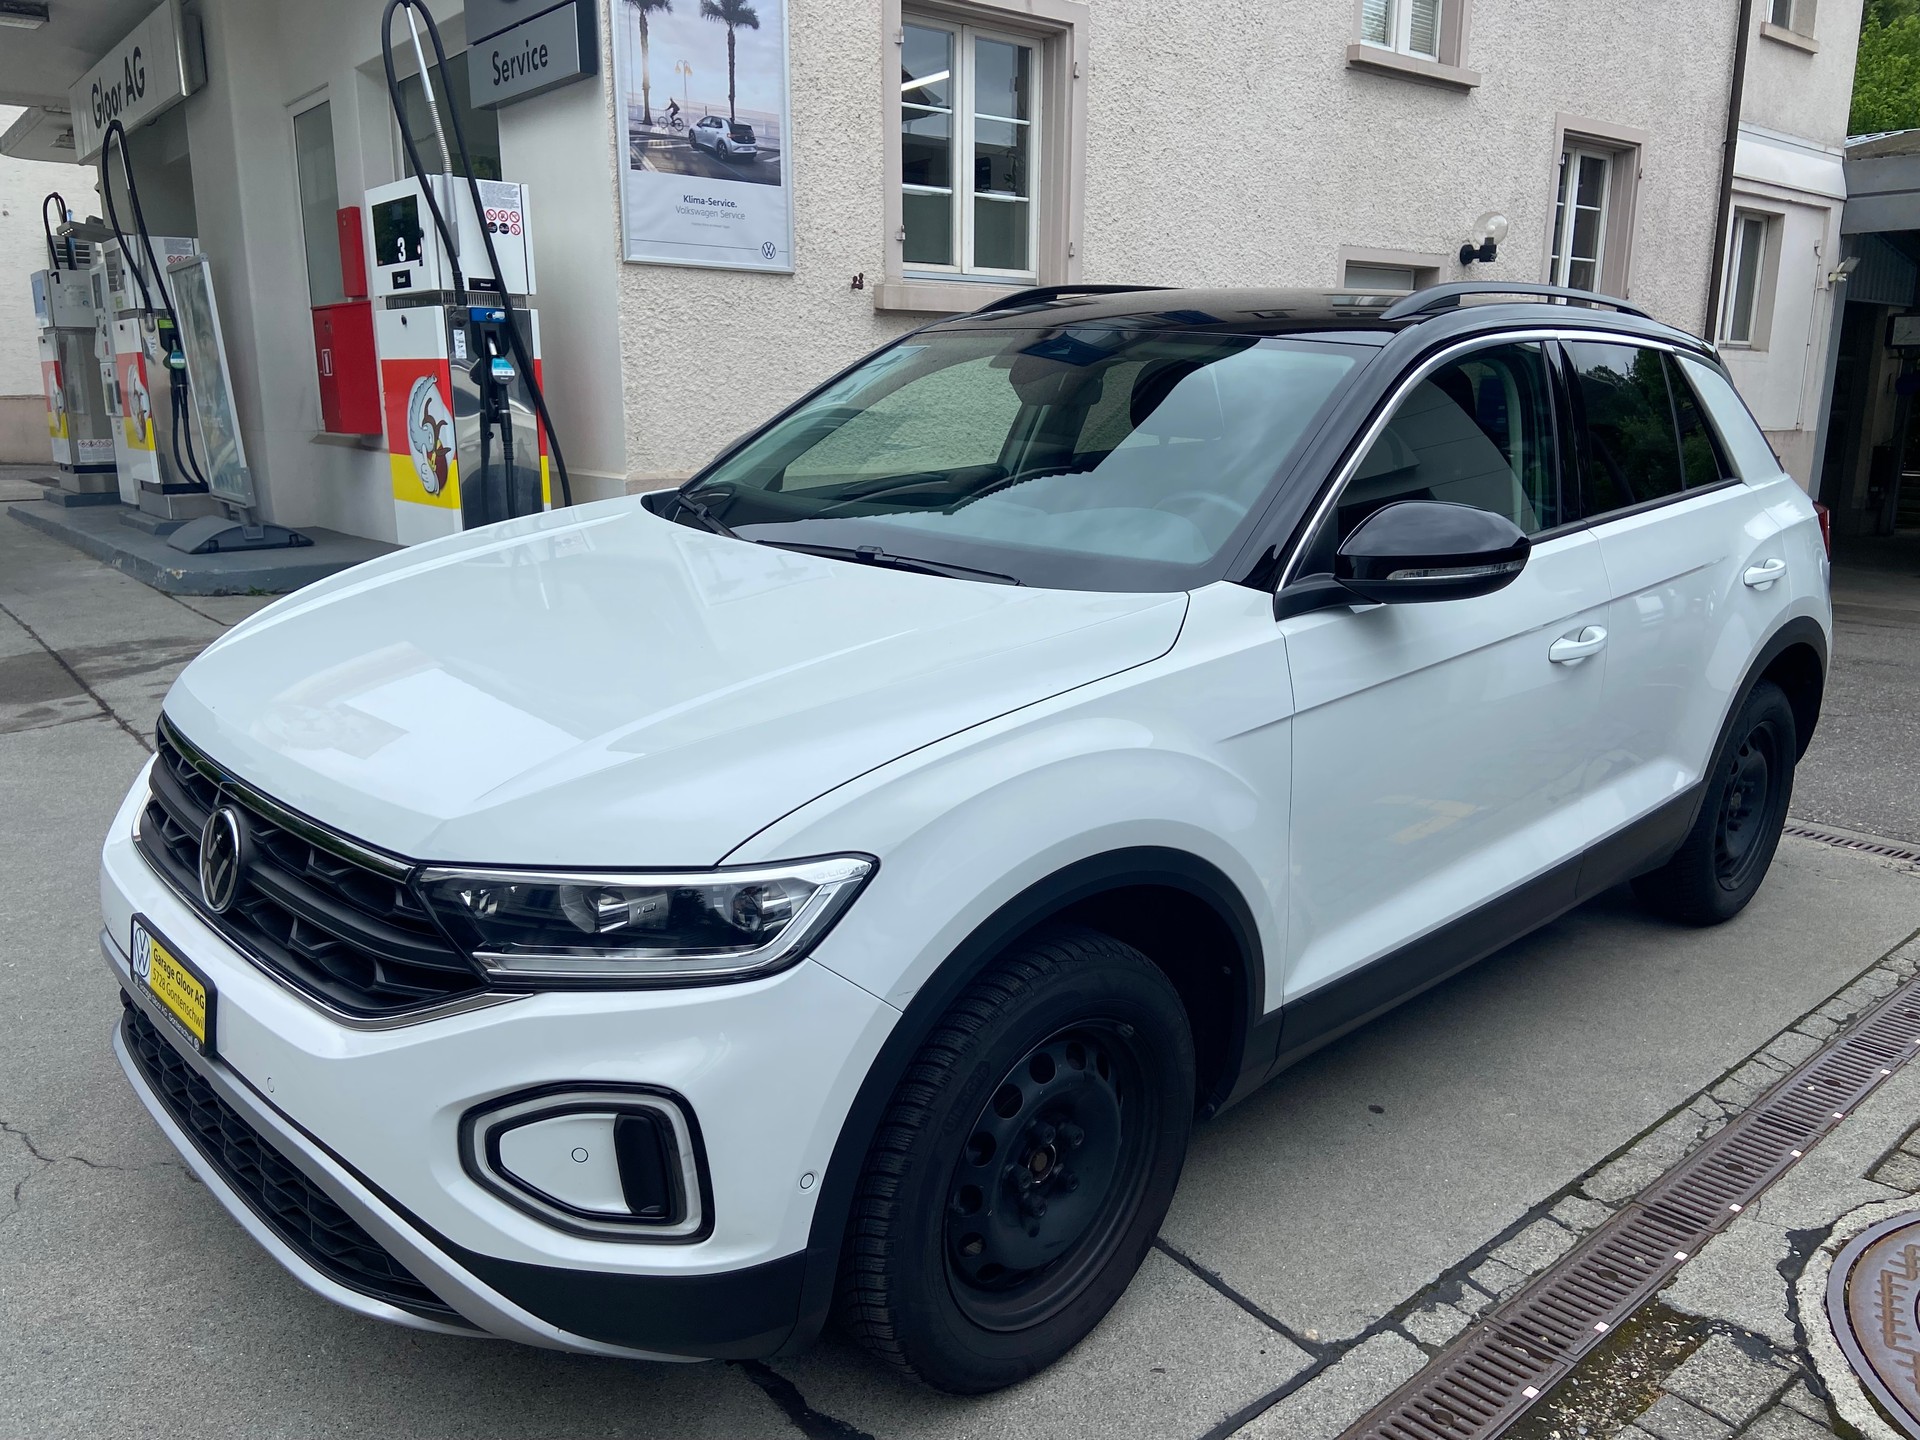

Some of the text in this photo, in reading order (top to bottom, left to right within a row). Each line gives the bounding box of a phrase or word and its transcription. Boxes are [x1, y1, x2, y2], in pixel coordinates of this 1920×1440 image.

[492, 39, 548, 86] Service
[92, 46, 145, 129] Gloor AG
[675, 205, 746, 220] Volkswagen Service
[683, 194, 738, 208] Klima-Service.
[397, 236, 407, 262] 3
[50, 271, 61, 285] 1
[153, 948, 205, 1010] Garage Gloor AG
[152, 967, 205, 1031] 5728 Gontenschwil
